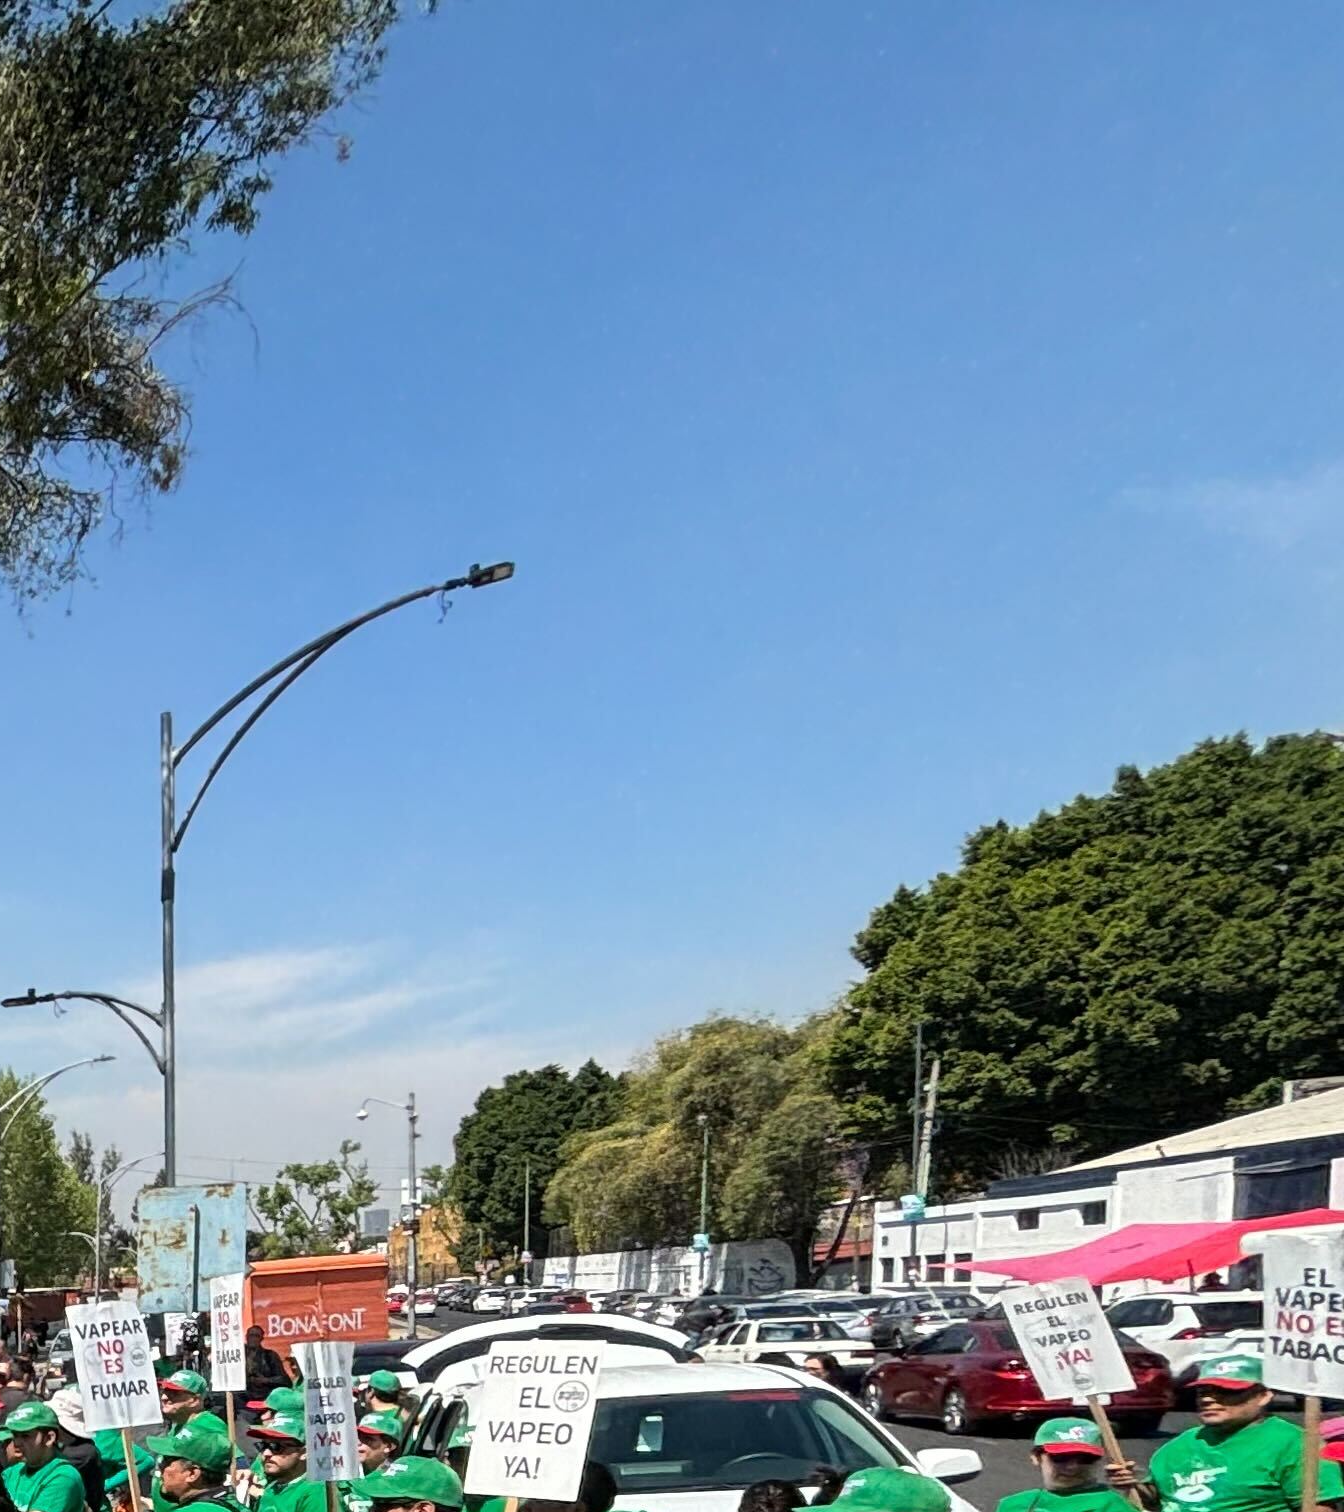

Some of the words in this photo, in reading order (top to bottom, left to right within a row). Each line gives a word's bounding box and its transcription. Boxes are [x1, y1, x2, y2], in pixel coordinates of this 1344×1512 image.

[1303, 1267, 1335, 1287] EL
[1013, 1292, 1088, 1315] REGULEN
[1275, 1287, 1344, 1313] VAPE
[74, 1319, 143, 1340] VAPEAR
[1047, 1315, 1067, 1328] EL
[1276, 1311, 1314, 1334] NO
[97, 1338, 124, 1356] NO
[1034, 1329, 1091, 1348] VAPEO
[104, 1358, 124, 1375] ES
[489, 1355, 599, 1376] REGULEN
[1054, 1348, 1094, 1370] ¡YA!
[91, 1379, 150, 1401] FUMAR
[518, 1386, 551, 1409] EL
[319, 1396, 333, 1407] EL
[488, 1420, 573, 1445] VAPEO
[504, 1455, 541, 1480] YA!
